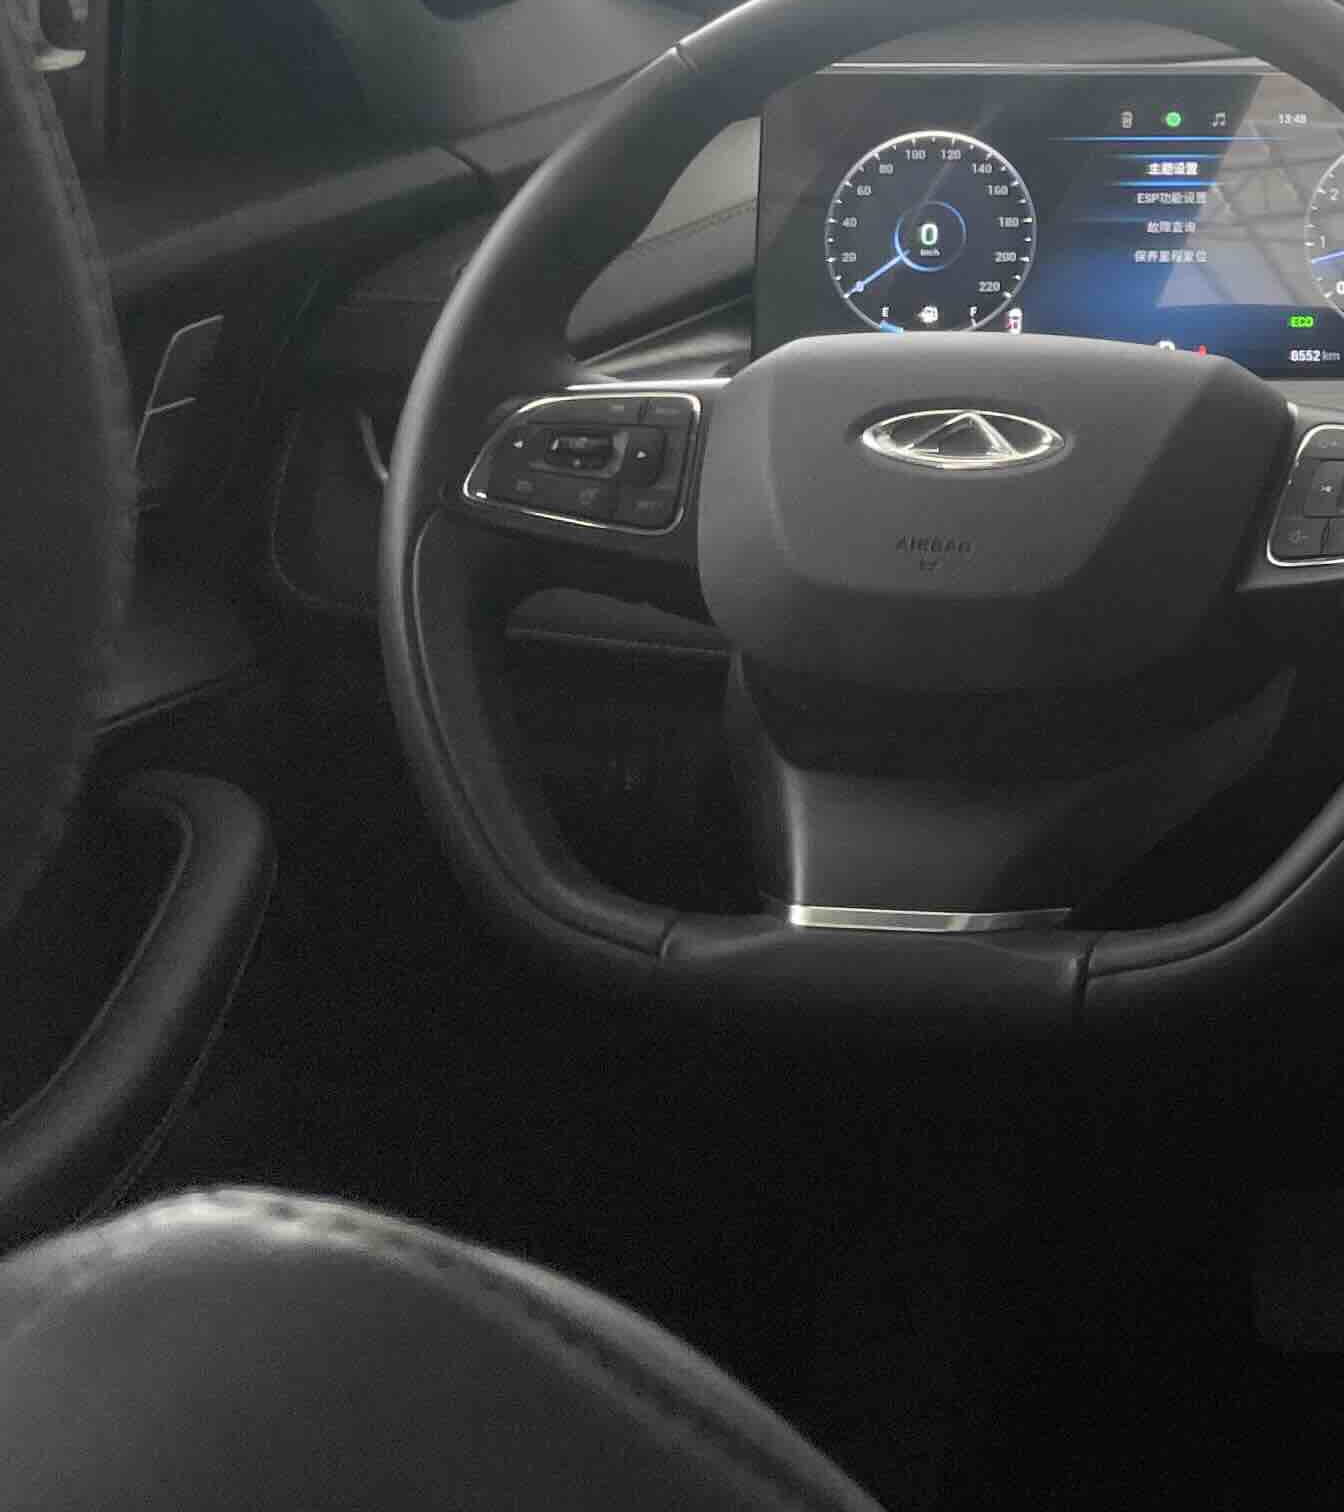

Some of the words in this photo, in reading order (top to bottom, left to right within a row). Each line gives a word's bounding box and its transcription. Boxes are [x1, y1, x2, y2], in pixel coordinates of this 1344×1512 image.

[906, 150, 925, 160] 100
[941, 150, 961, 160] 120
[879, 164, 894, 174] 80
[973, 164, 992, 174] 140
[856, 185, 872, 196] 60
[988, 185, 1008, 196] 160
[1329, 188, 1340, 200] 2
[842, 217, 857, 227] 40
[999, 217, 1019, 227] 180
[921, 223, 938, 245] 0
[1319, 235, 1326, 248] 1
[842, 252, 857, 262] 20
[995, 251, 1016, 262] 200
[978, 282, 1001, 292] 220
[881, 307, 889, 318] E
[970, 307, 977, 317] F
[1290, 317, 1313, 327] ECO
[1322, 350, 1341, 361] km
